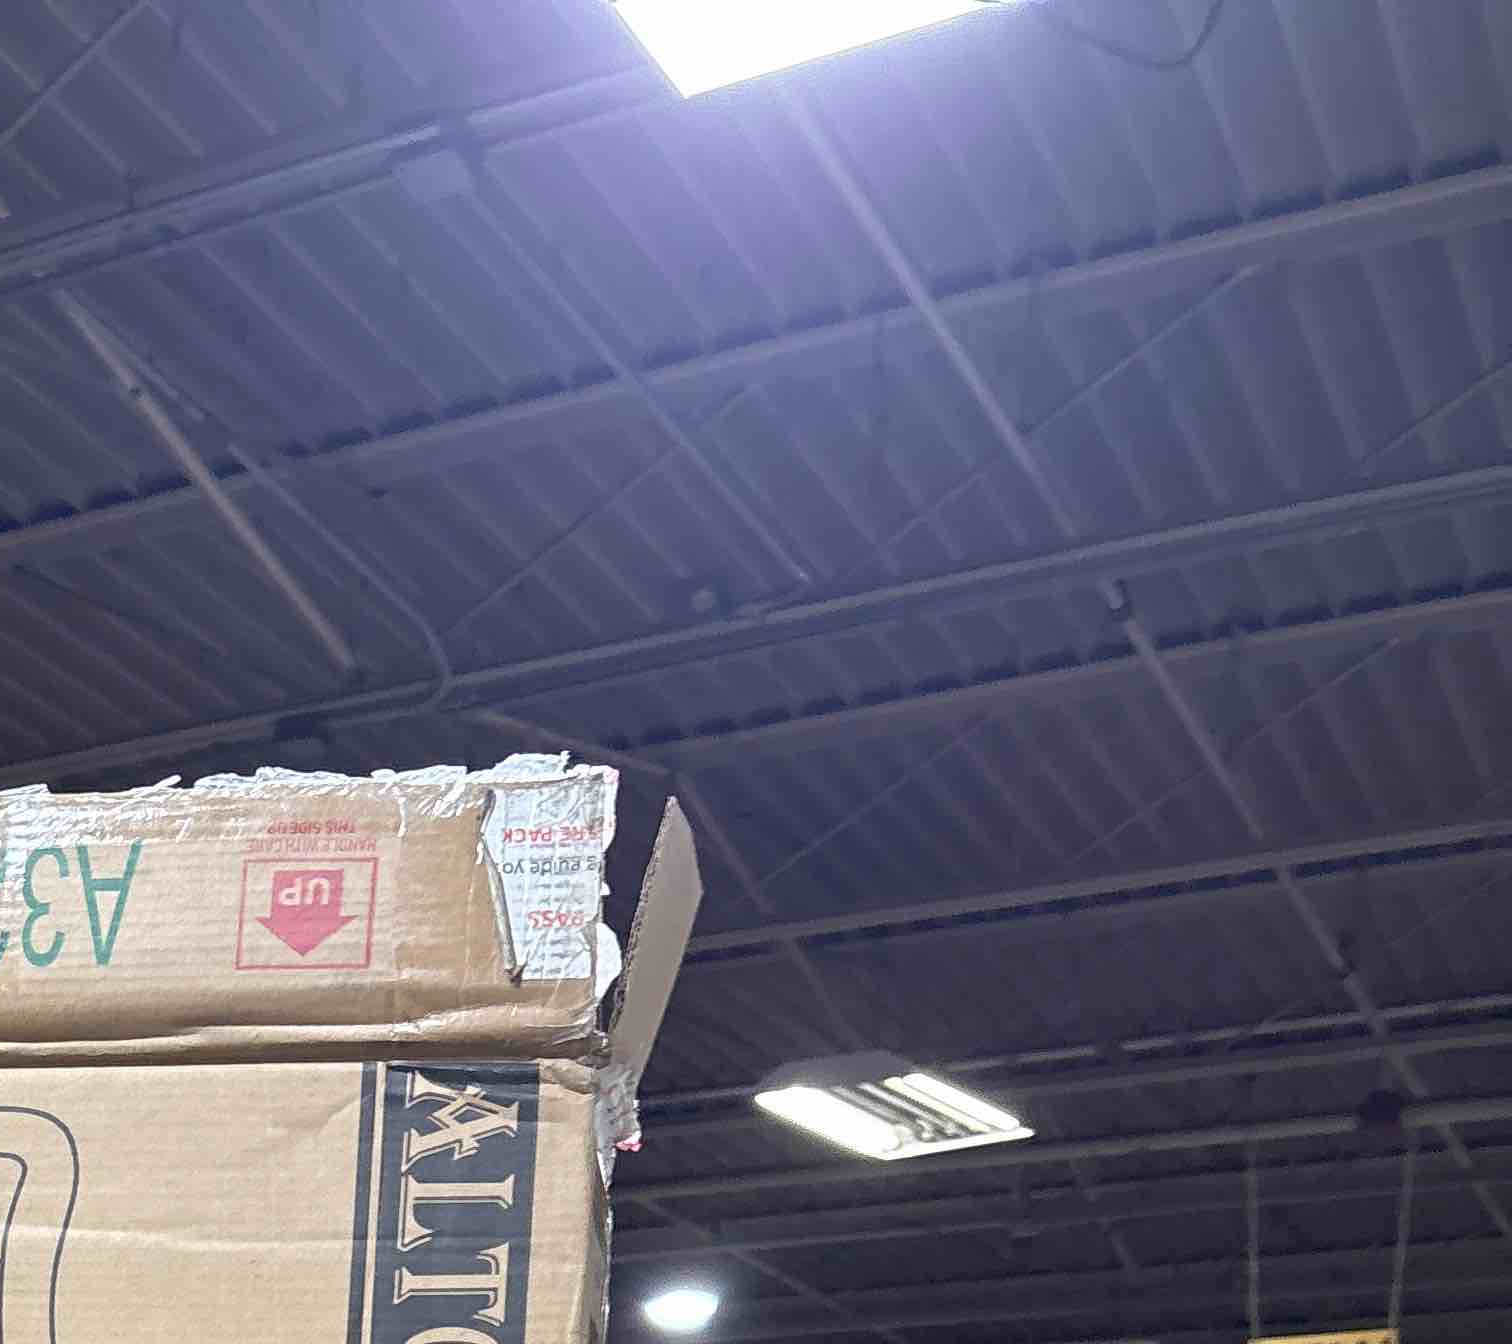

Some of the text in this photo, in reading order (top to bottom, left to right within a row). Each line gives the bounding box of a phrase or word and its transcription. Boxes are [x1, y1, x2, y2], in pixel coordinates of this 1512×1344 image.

[289, 821, 322, 834] SIDE
[326, 820, 356, 834] THIS
[502, 828, 553, 844] PACK
[277, 878, 330, 906] UP
